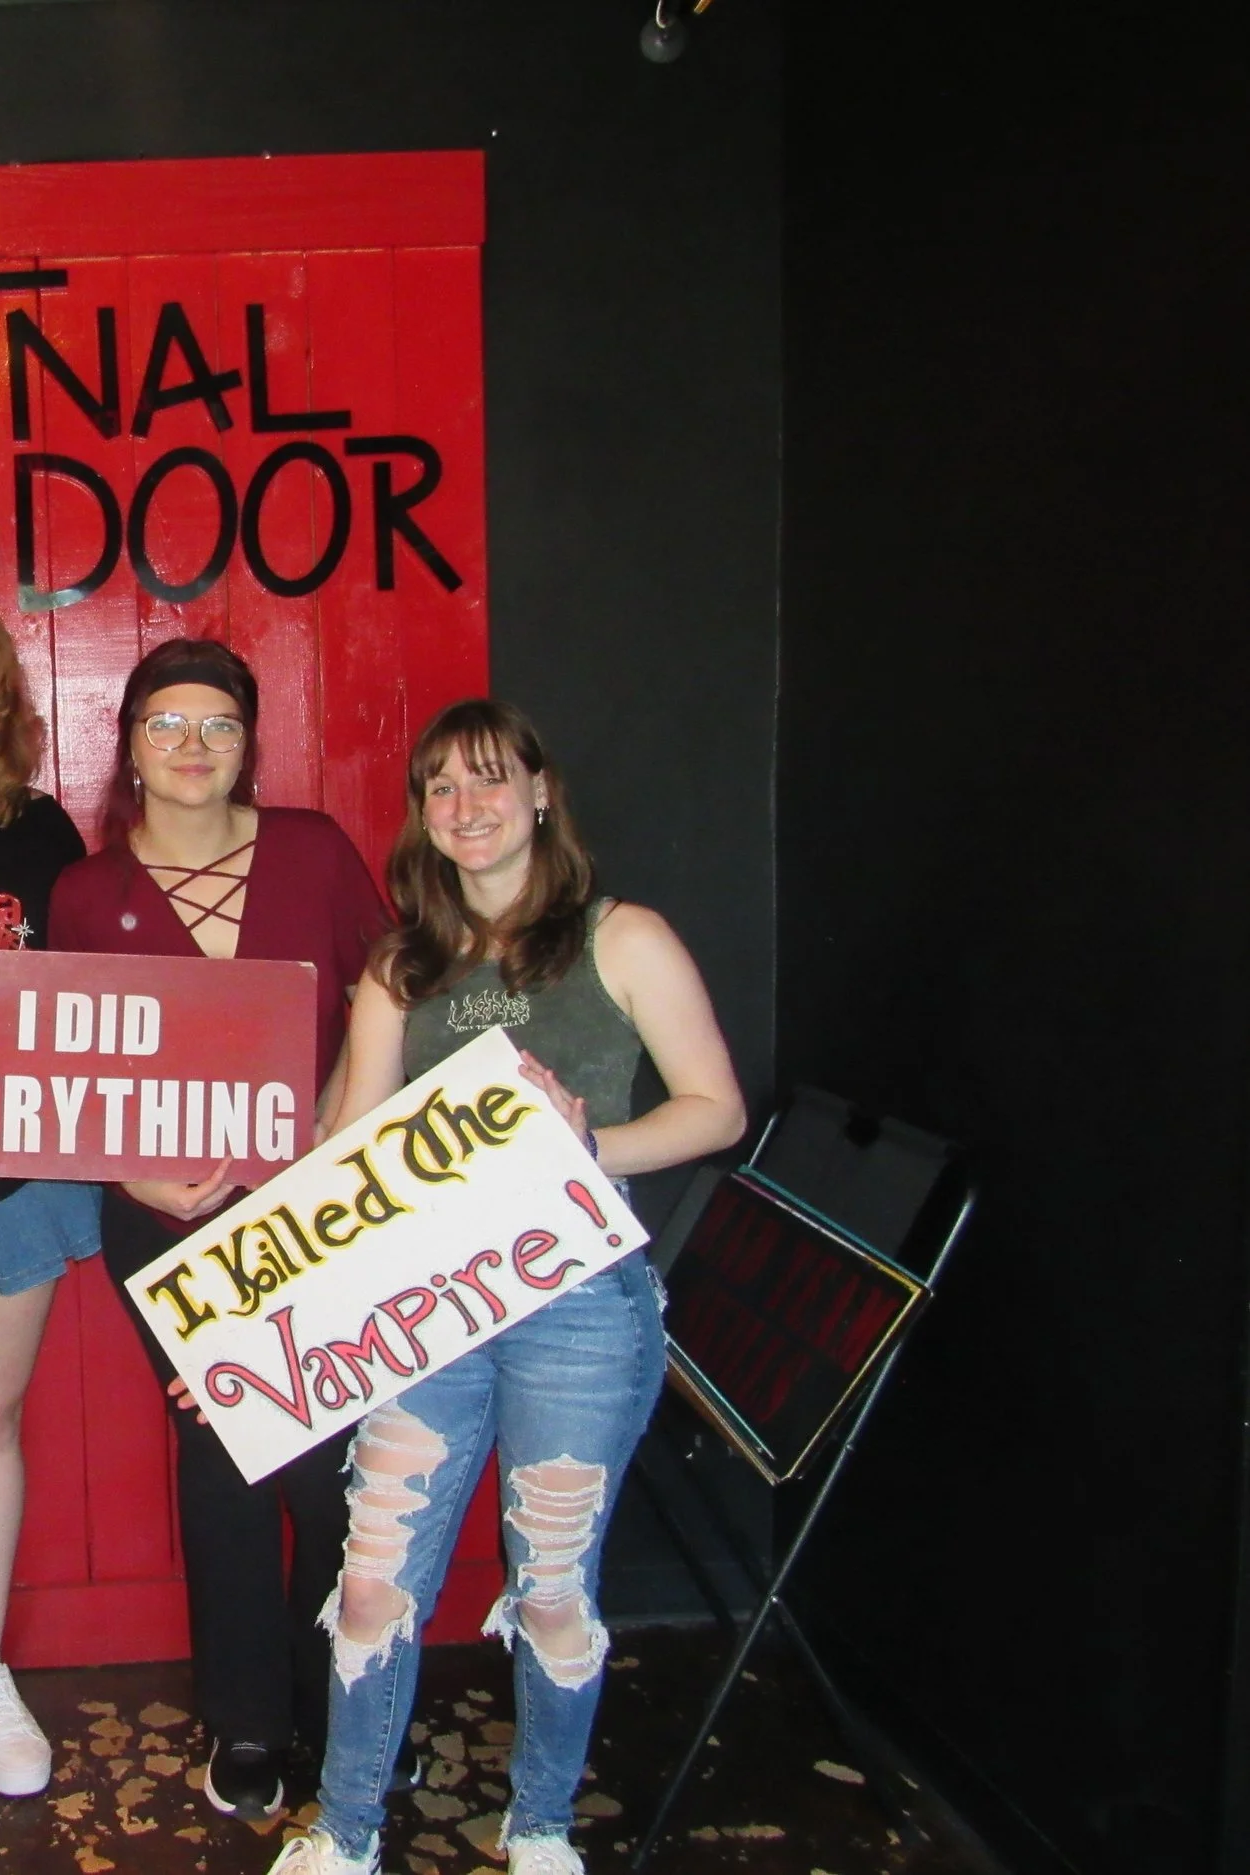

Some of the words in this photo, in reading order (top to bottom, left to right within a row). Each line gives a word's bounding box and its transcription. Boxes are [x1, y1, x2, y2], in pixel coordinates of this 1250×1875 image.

[13, 435, 463, 612] DOOR
[18, 990, 37, 1051] I
[55, 991, 161, 1056] DID
[145, 1261, 218, 1343] I
[204, 1147, 415, 1318] Killed
[374, 1083, 542, 1185] The
